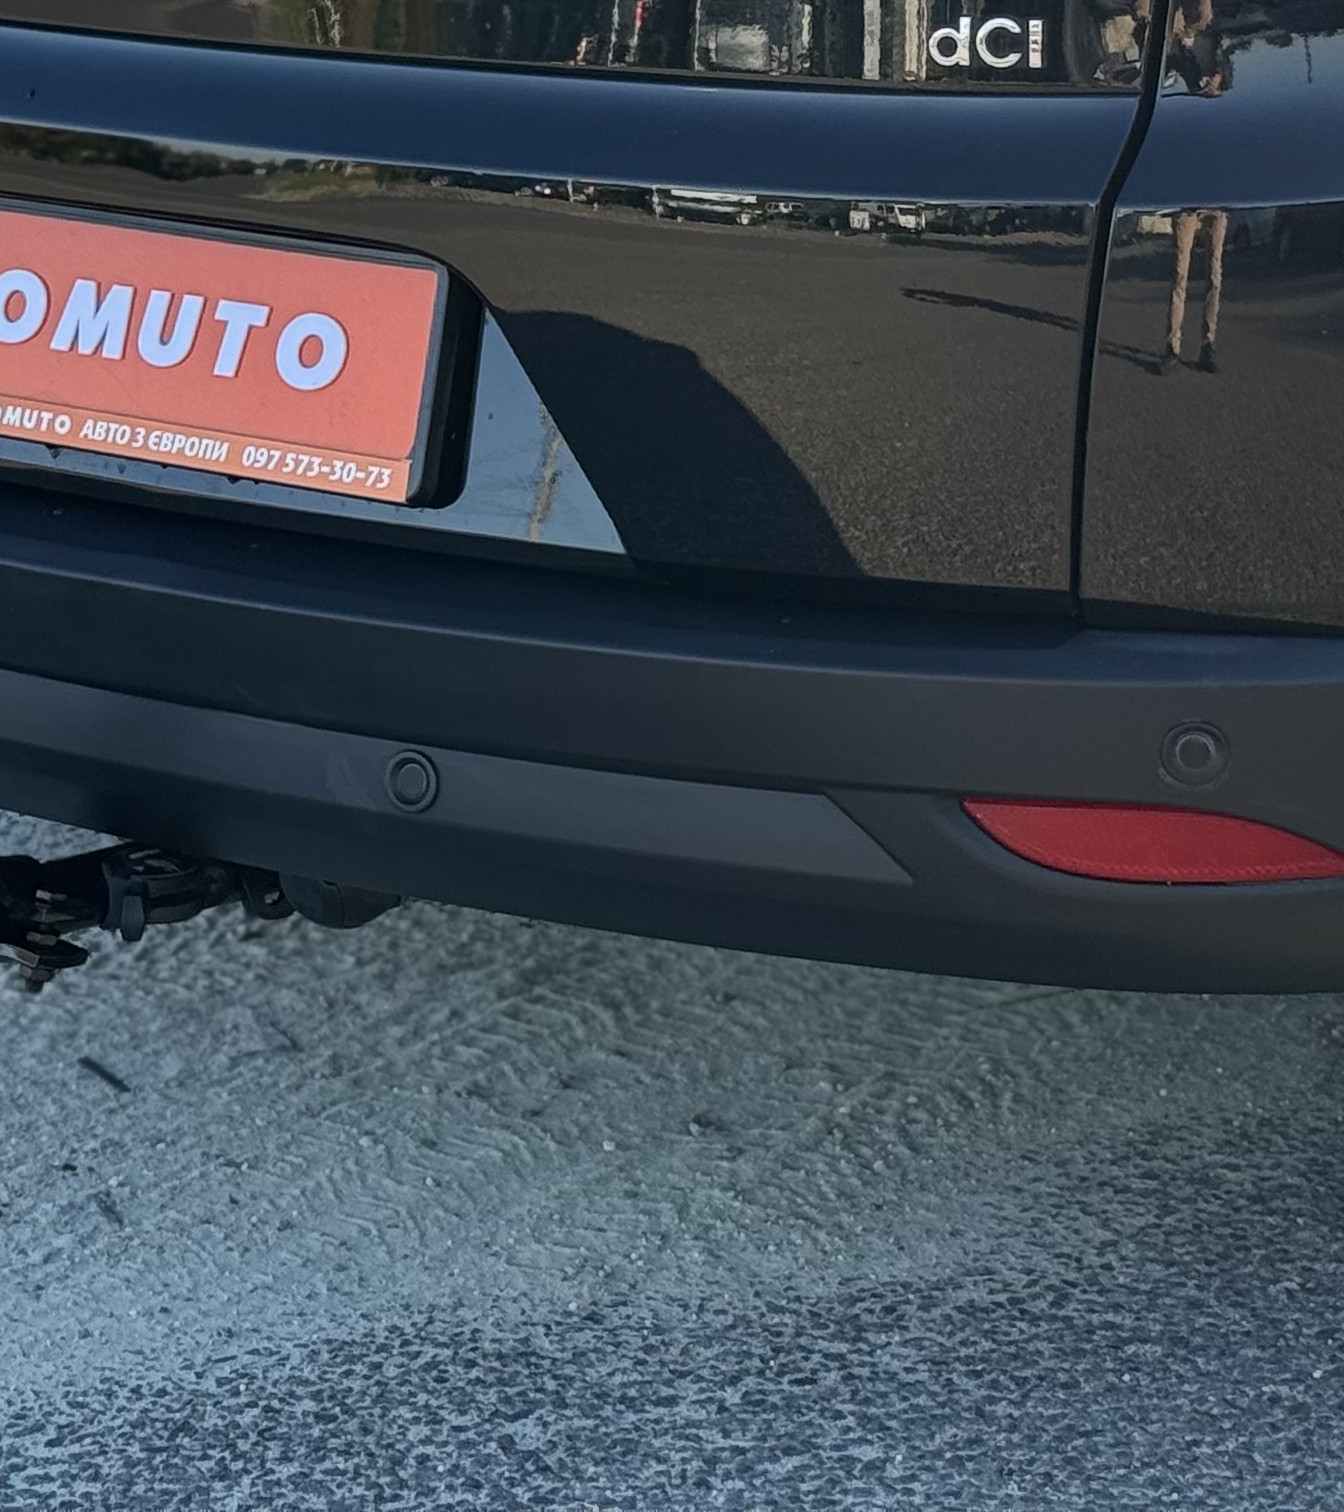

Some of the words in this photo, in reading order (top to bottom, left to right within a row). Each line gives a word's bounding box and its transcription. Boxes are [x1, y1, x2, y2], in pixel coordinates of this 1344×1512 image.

[928, 16, 1045, 68] dCi
[79, 418, 132, 446] АВТО
[147, 430, 230, 463] ЄВРОПИ
